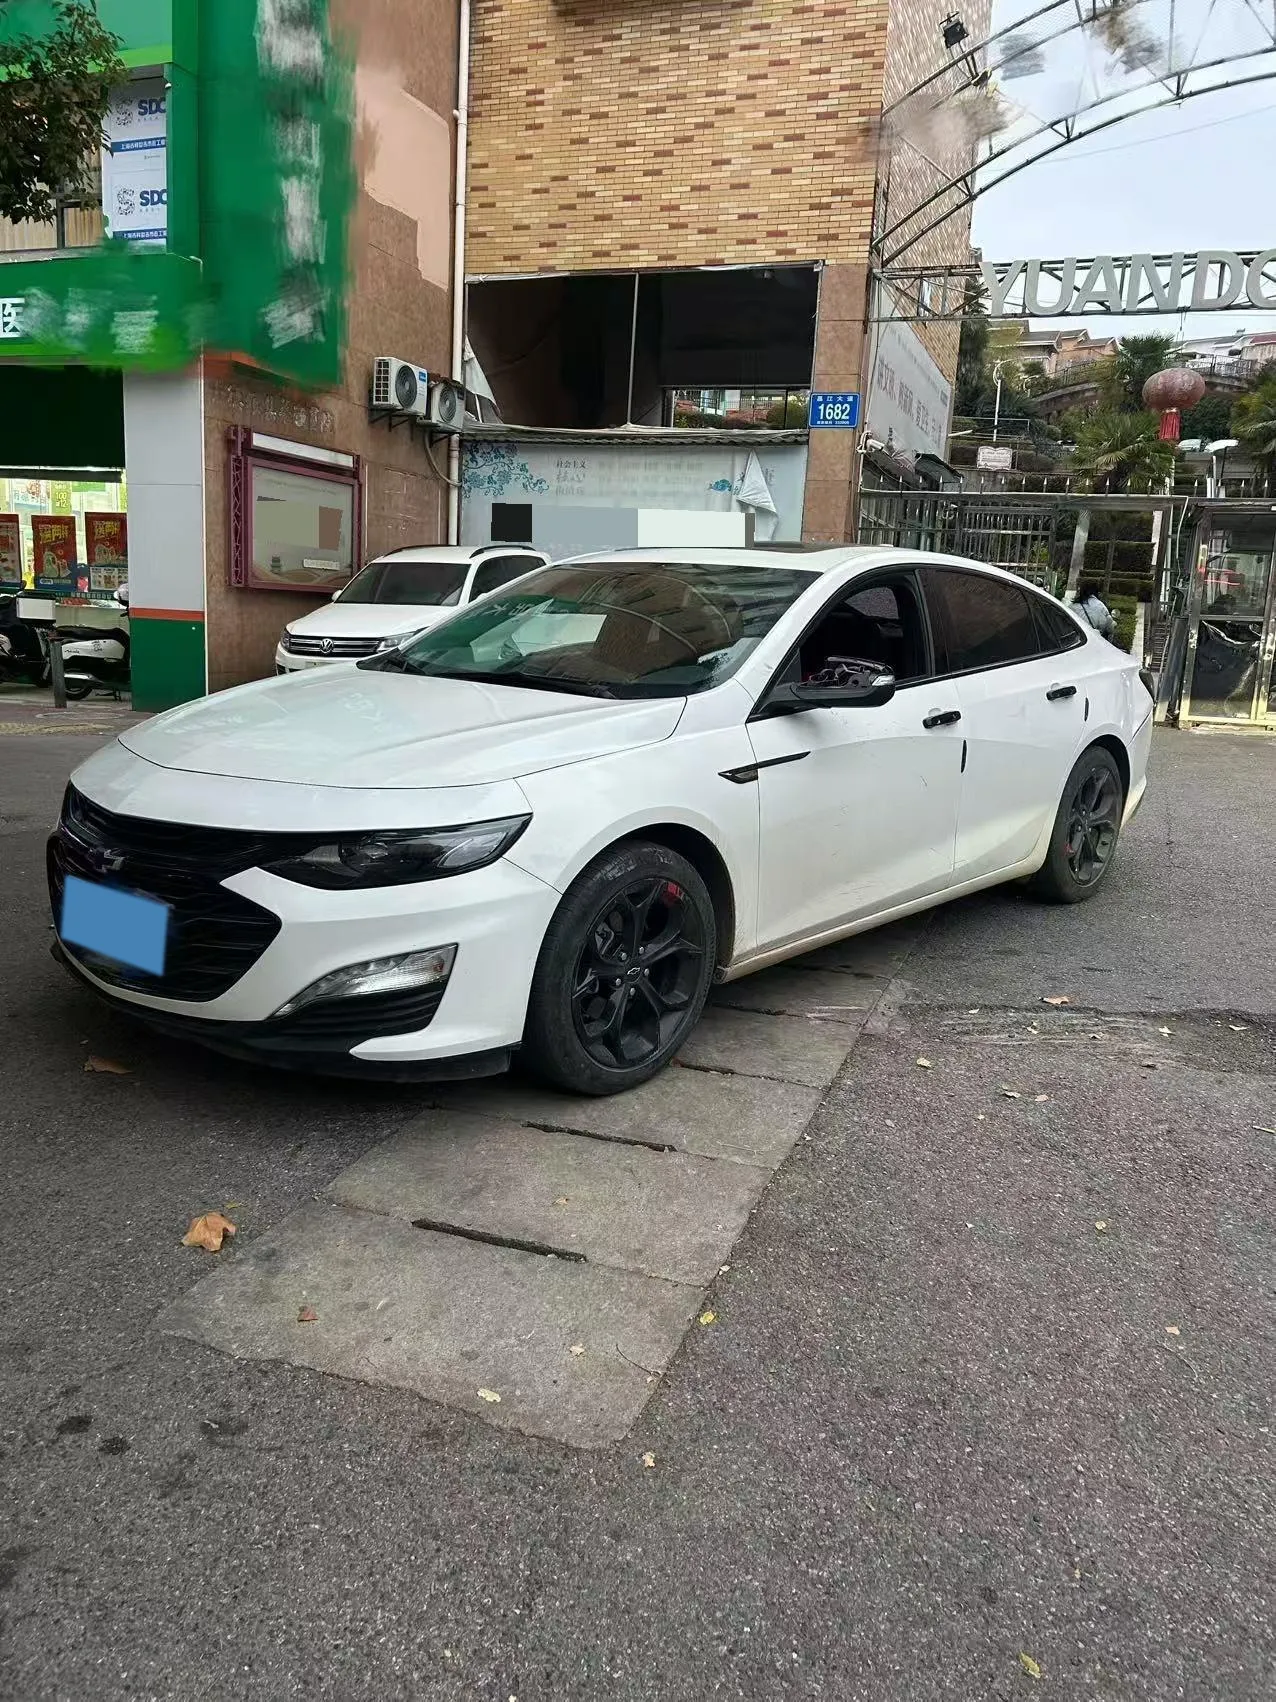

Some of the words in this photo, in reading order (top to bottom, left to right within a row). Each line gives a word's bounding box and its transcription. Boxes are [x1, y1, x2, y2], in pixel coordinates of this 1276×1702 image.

[818, 403, 850, 420] 1682
[556, 459, 586, 469] 社会主义
